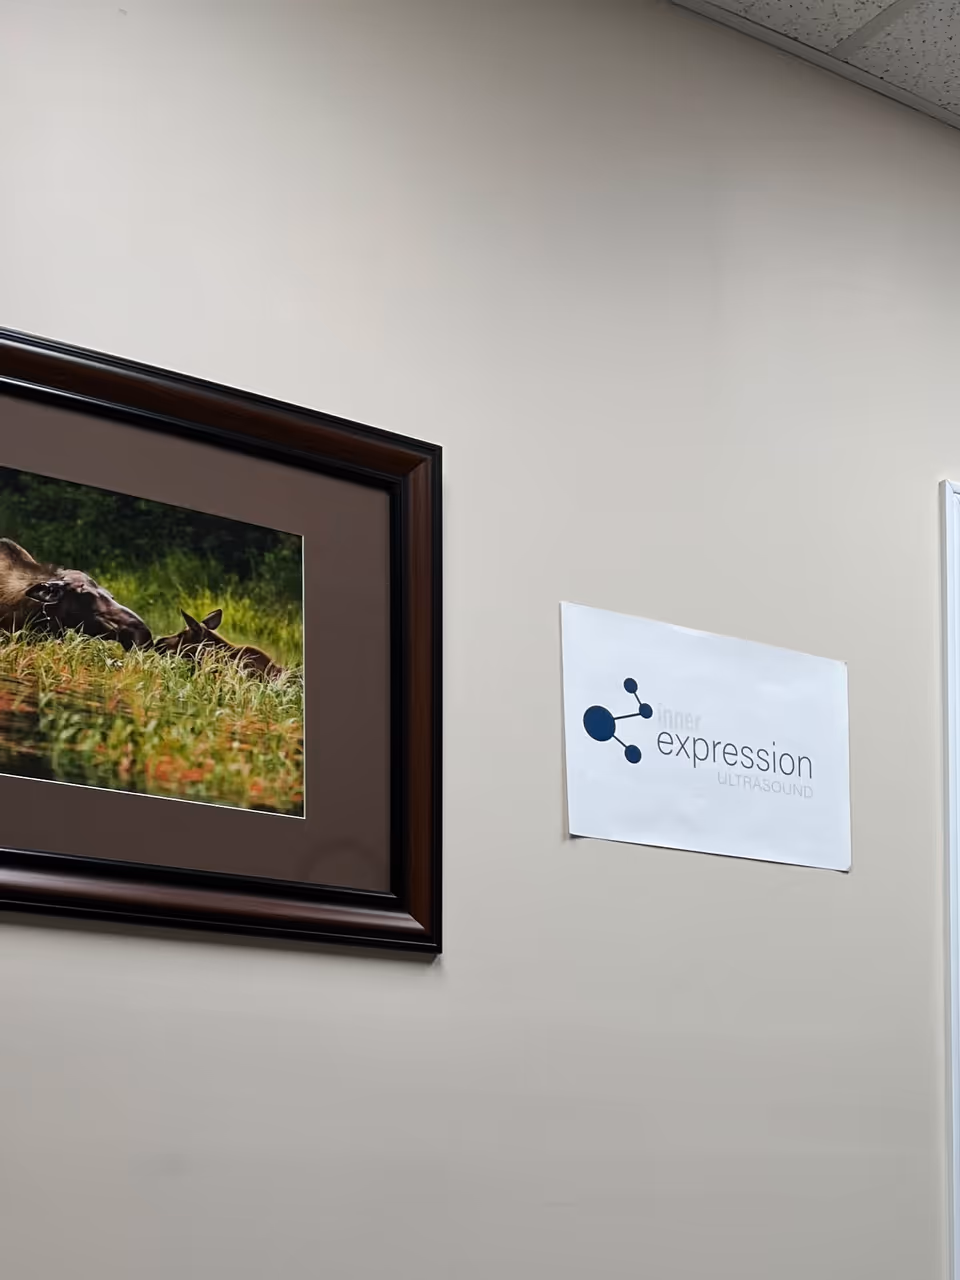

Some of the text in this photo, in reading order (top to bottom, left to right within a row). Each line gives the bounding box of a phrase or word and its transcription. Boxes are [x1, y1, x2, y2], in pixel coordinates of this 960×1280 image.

[657, 703, 702, 731] inner
[657, 731, 812, 779] expression
[717, 771, 813, 799] ULTRASOUND
